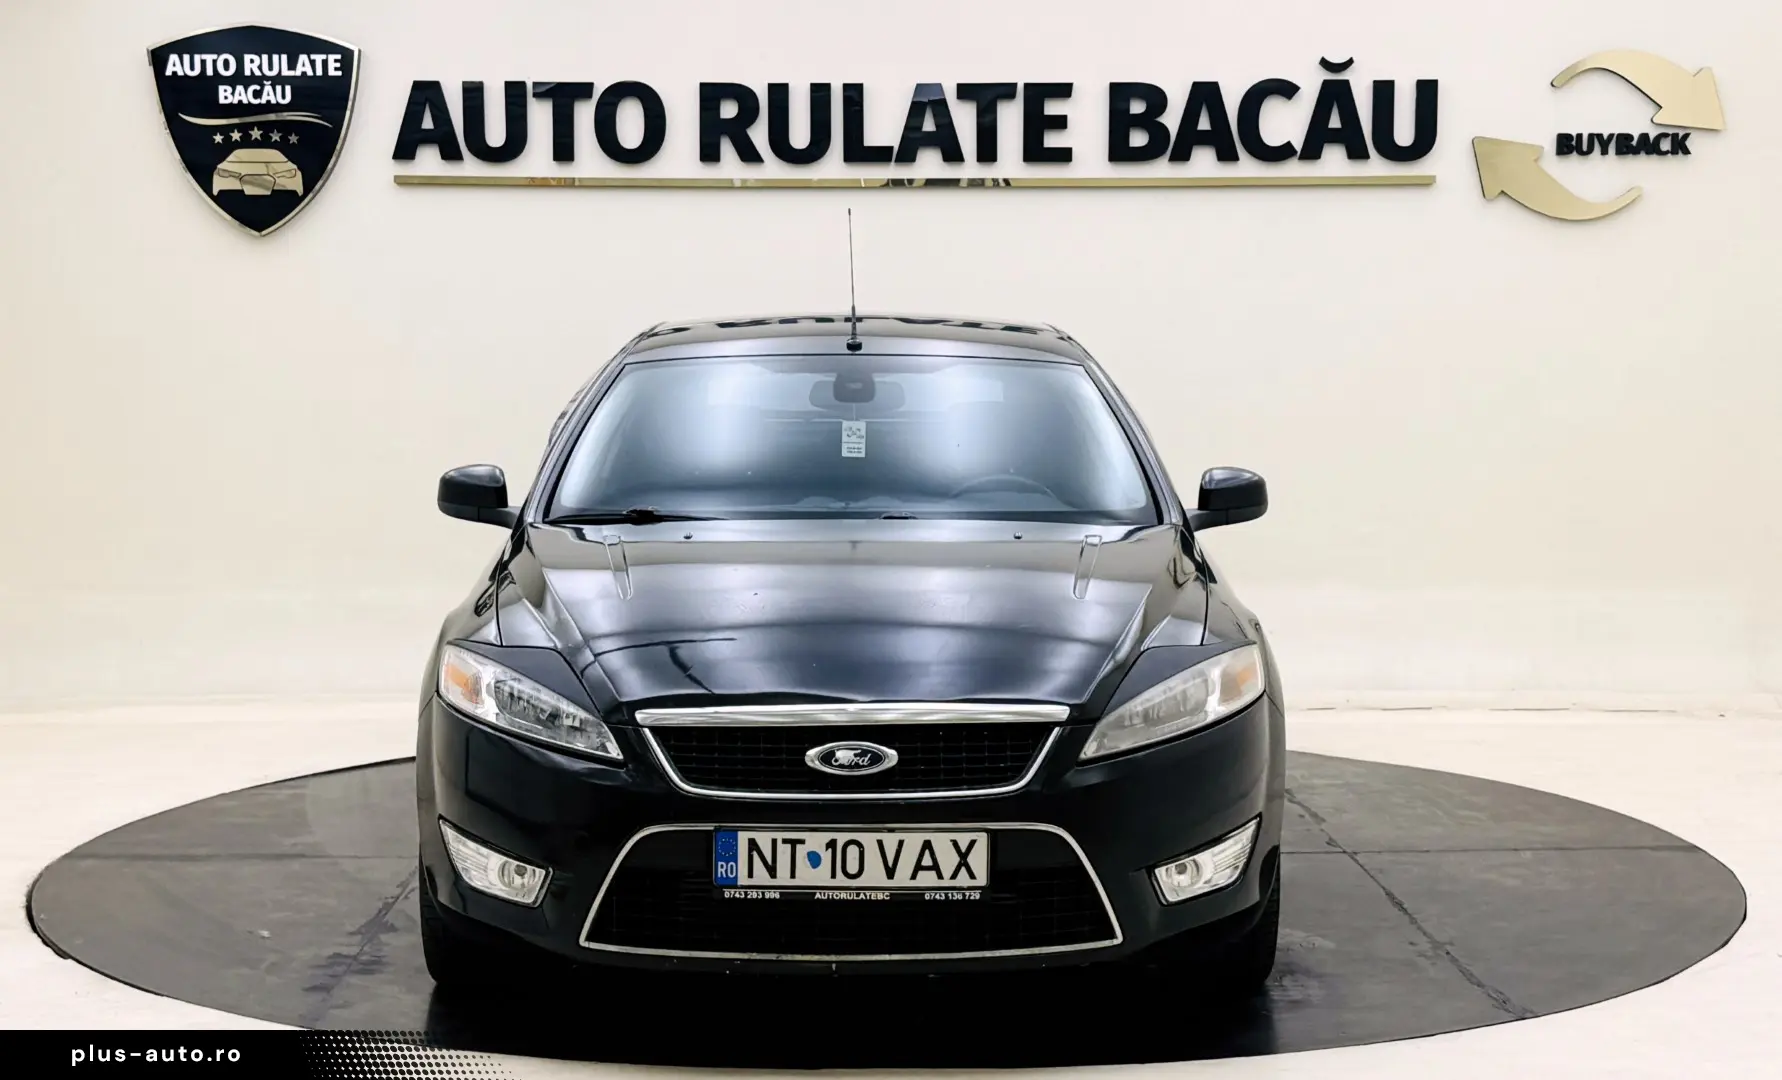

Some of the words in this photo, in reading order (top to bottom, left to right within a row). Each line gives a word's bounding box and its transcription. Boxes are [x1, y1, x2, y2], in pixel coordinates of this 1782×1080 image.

[164, 53, 237, 77] AUTO
[243, 53, 343, 77] RULATE
[218, 80, 292, 105] BACĂU
[392, 80, 667, 164] AUTO
[699, 82, 1074, 165] RULATE
[1107, 56, 1439, 163] BACĂU
[1555, 132, 1692, 158] BUYBACK
[717, 861, 737, 878] RO
[747, 837, 806, 880] NT
[824, 838, 865, 880] 10
[876, 838, 978, 881] VAX
[814, 892, 891, 900] AUTORULATEBC
